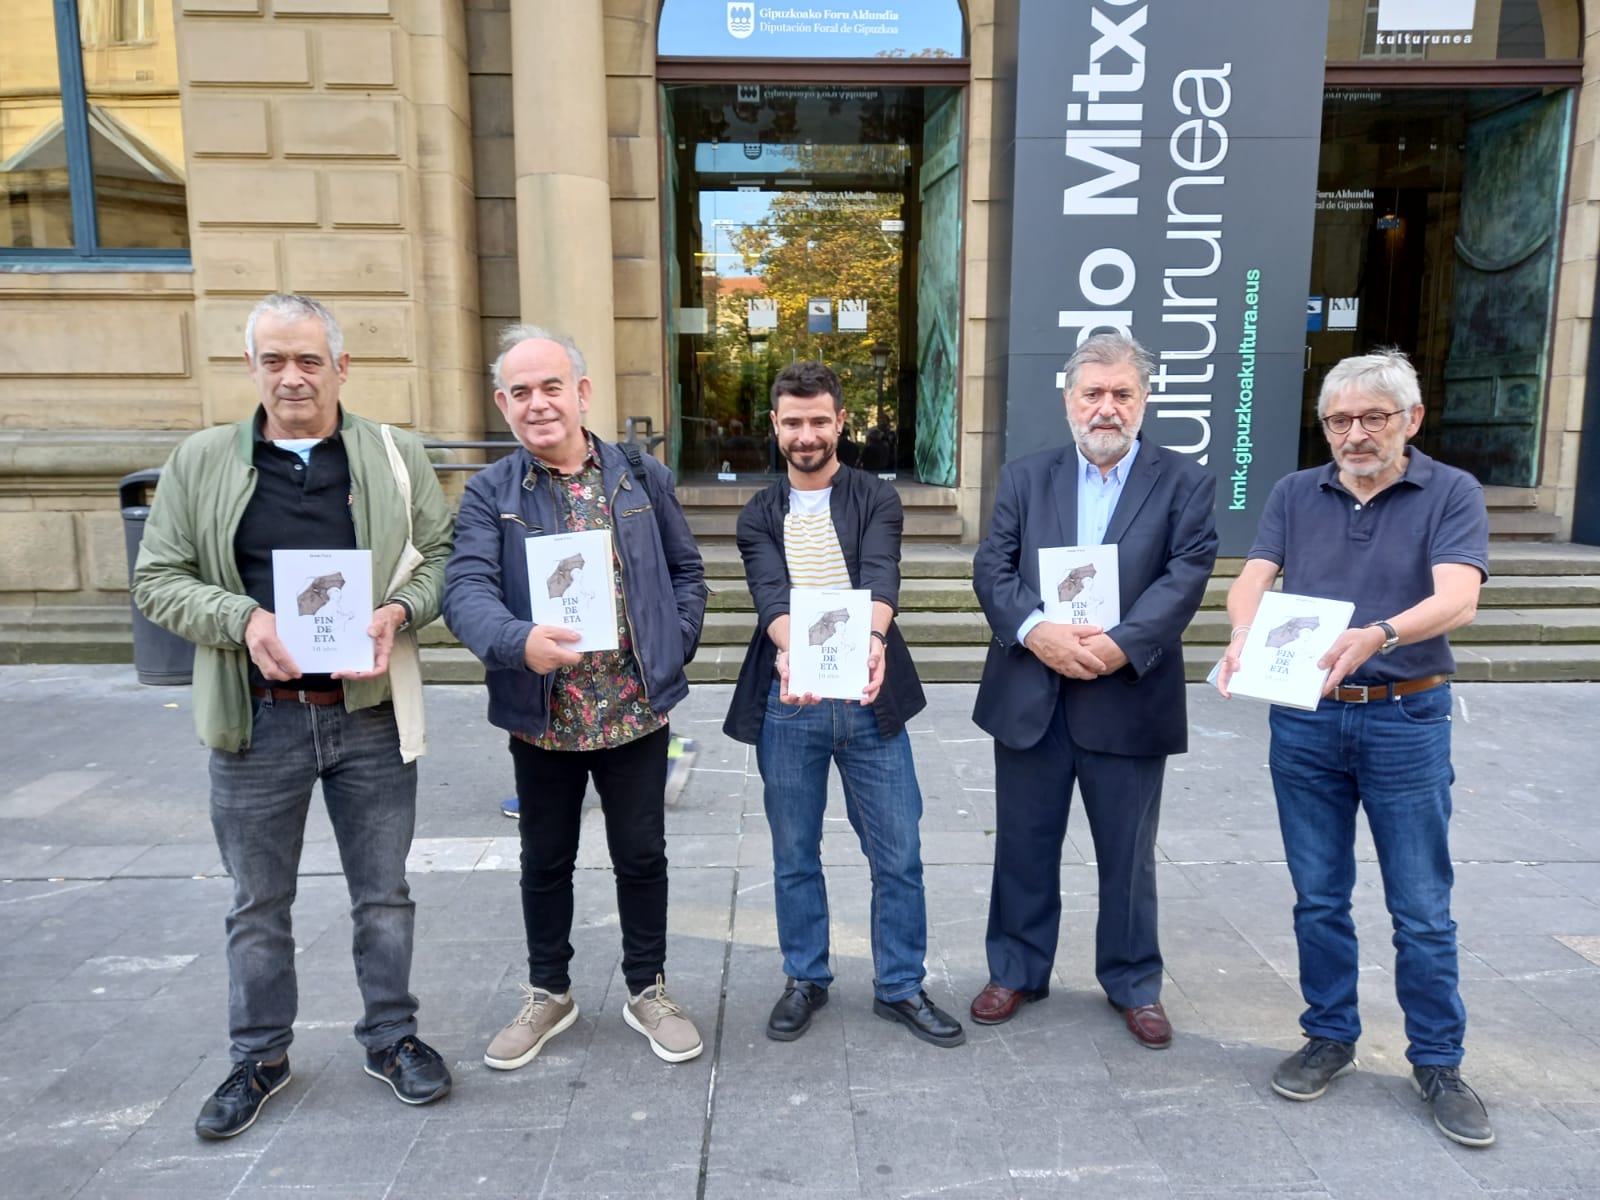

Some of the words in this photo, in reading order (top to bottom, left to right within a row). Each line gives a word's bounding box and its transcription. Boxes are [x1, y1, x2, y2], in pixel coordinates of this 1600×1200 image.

[760, 8, 821, 20] Gipuzkoako
[824, 9, 849, 20] Foru
[850, 10, 899, 20] Aldundia
[760, 22, 811, 34] Diputación
[814, 23, 839, 33] Foral
[840, 23, 852, 33] de
[854, 24, 899, 36] Gipuzkoa
[1376, 33, 1473, 44] kulturunea
[1063, 0, 1148, 216] Mitx
[1335, 189, 1374, 199] Aldundia
[1337, 200, 1374, 211] Gipuzkoa
[1147, 62, 1232, 466] ulturunea
[841, 299, 864, 312] KM
[1332, 298, 1355, 311] KM
[1229, 268, 1261, 510] kmk.gipuzkoakultura.eus
[562, 597, 579, 606] FIN
[565, 606, 578, 615] DE
[314, 617, 334, 625] FIN
[563, 616, 582, 624] ETA
[314, 635, 336, 643] ETA
[1276, 650, 1296, 659] FIN
[820, 663, 839, 671] ETA
[1275, 658, 1290, 667] DE
[1270, 665, 1289, 675] ETA
